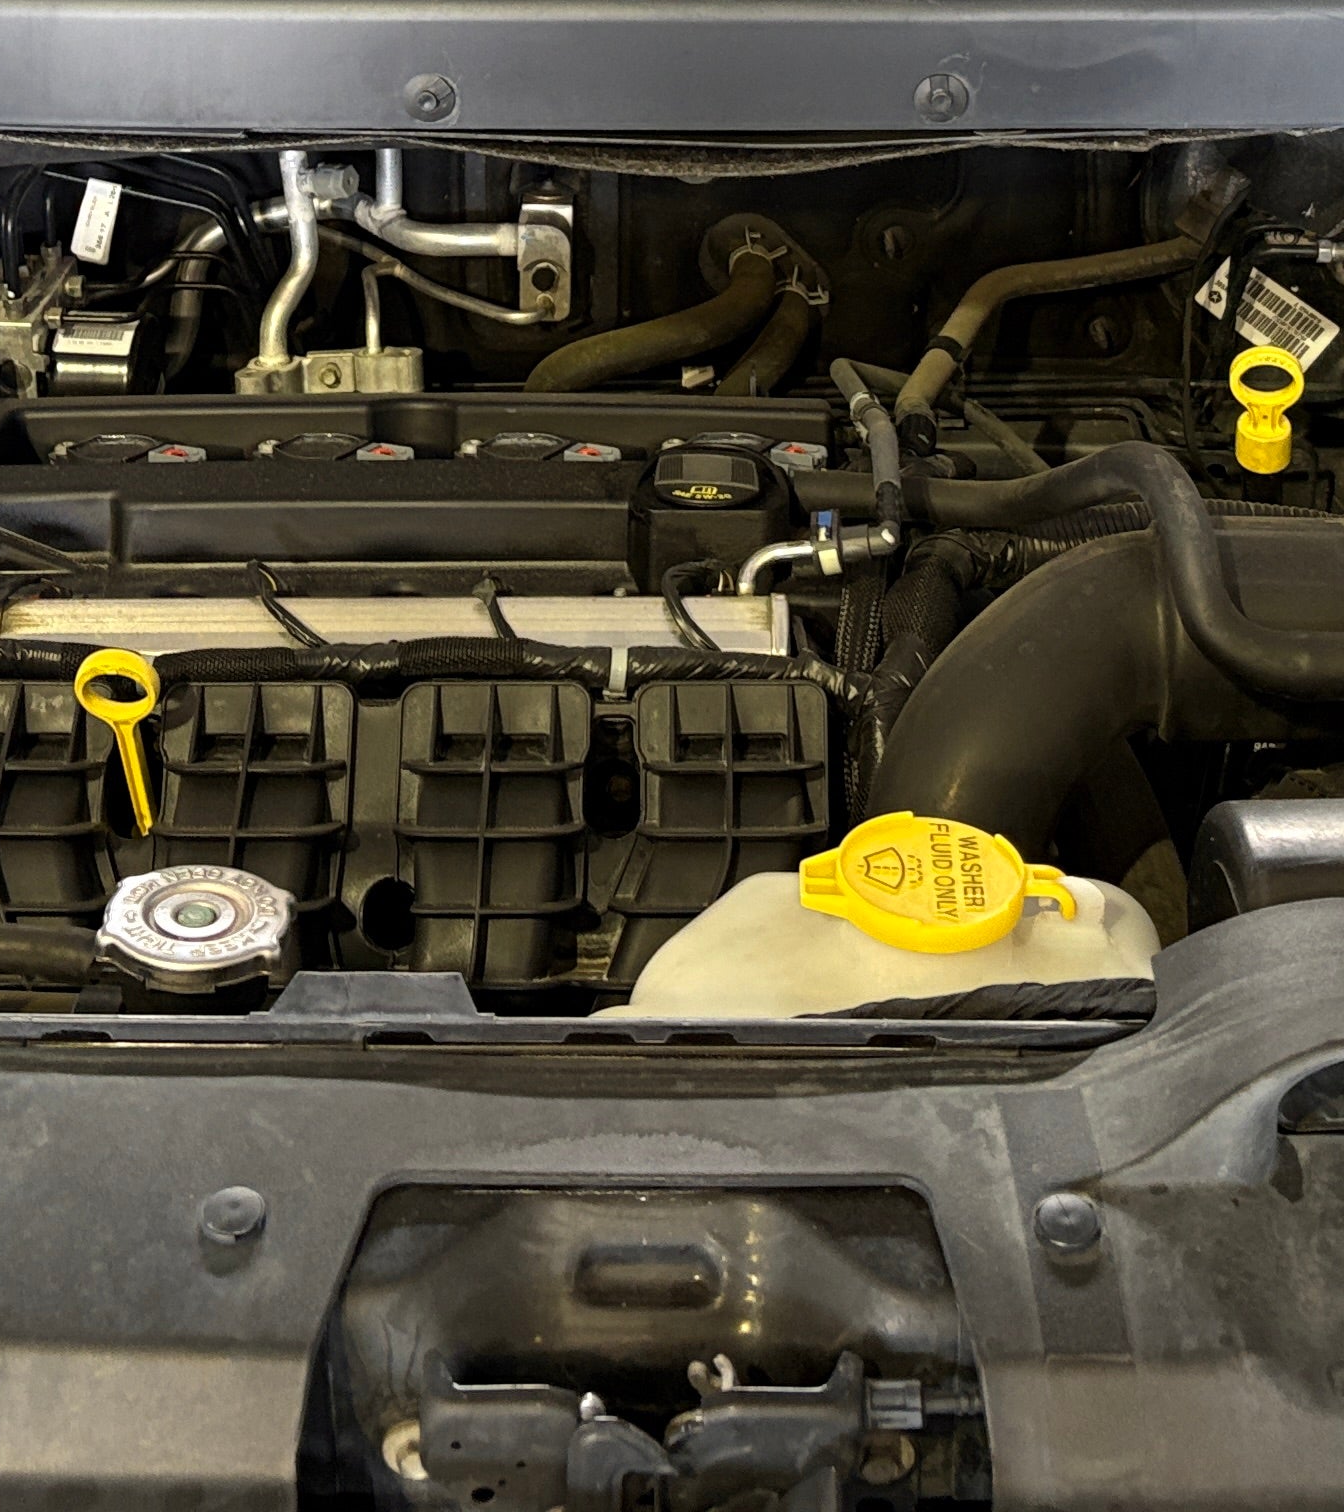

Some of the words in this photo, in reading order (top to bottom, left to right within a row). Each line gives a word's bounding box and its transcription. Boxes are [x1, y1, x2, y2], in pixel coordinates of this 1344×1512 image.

[928, 822, 954, 871] FLUID
[933, 874, 961, 920] ONLY
[957, 835, 987, 910] WASHER
